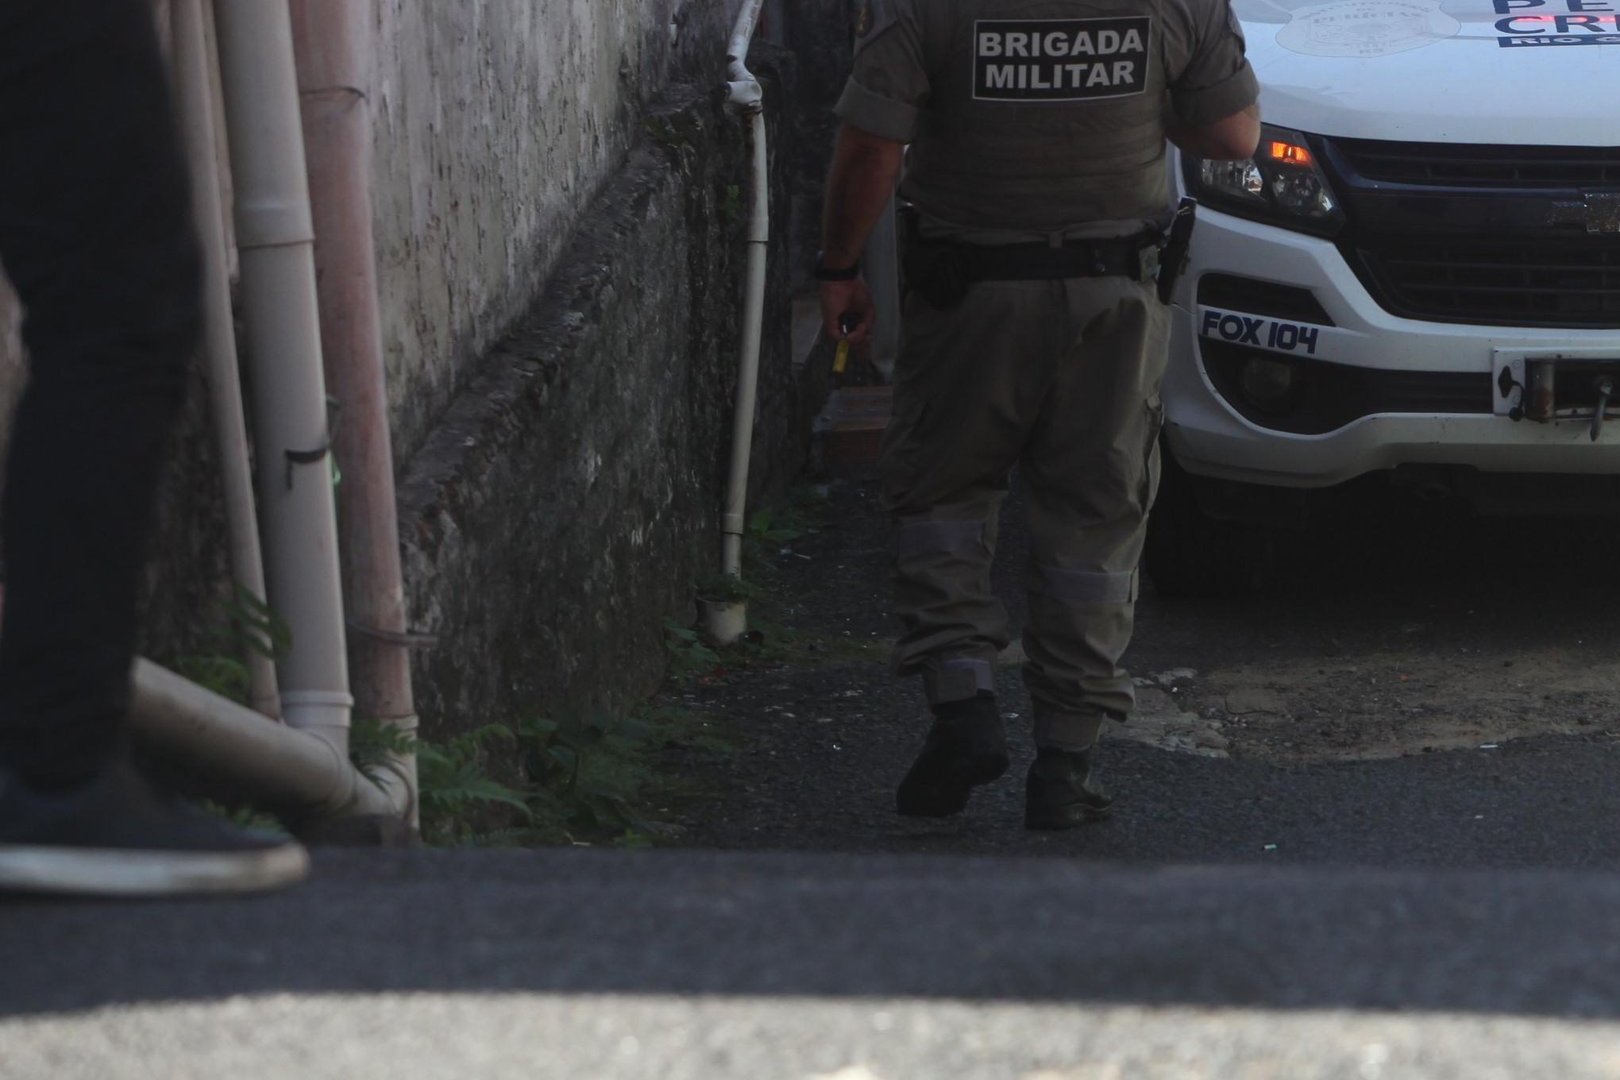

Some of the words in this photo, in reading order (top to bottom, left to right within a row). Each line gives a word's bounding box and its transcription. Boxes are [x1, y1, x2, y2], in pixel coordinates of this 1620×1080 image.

[978, 28, 1144, 57] BRIGADA
[1510, 36, 1583, 45] RIO
[985, 60, 1135, 89] MILITAR
[1202, 310, 1264, 346] FOX
[1267, 321, 1319, 354] 104
